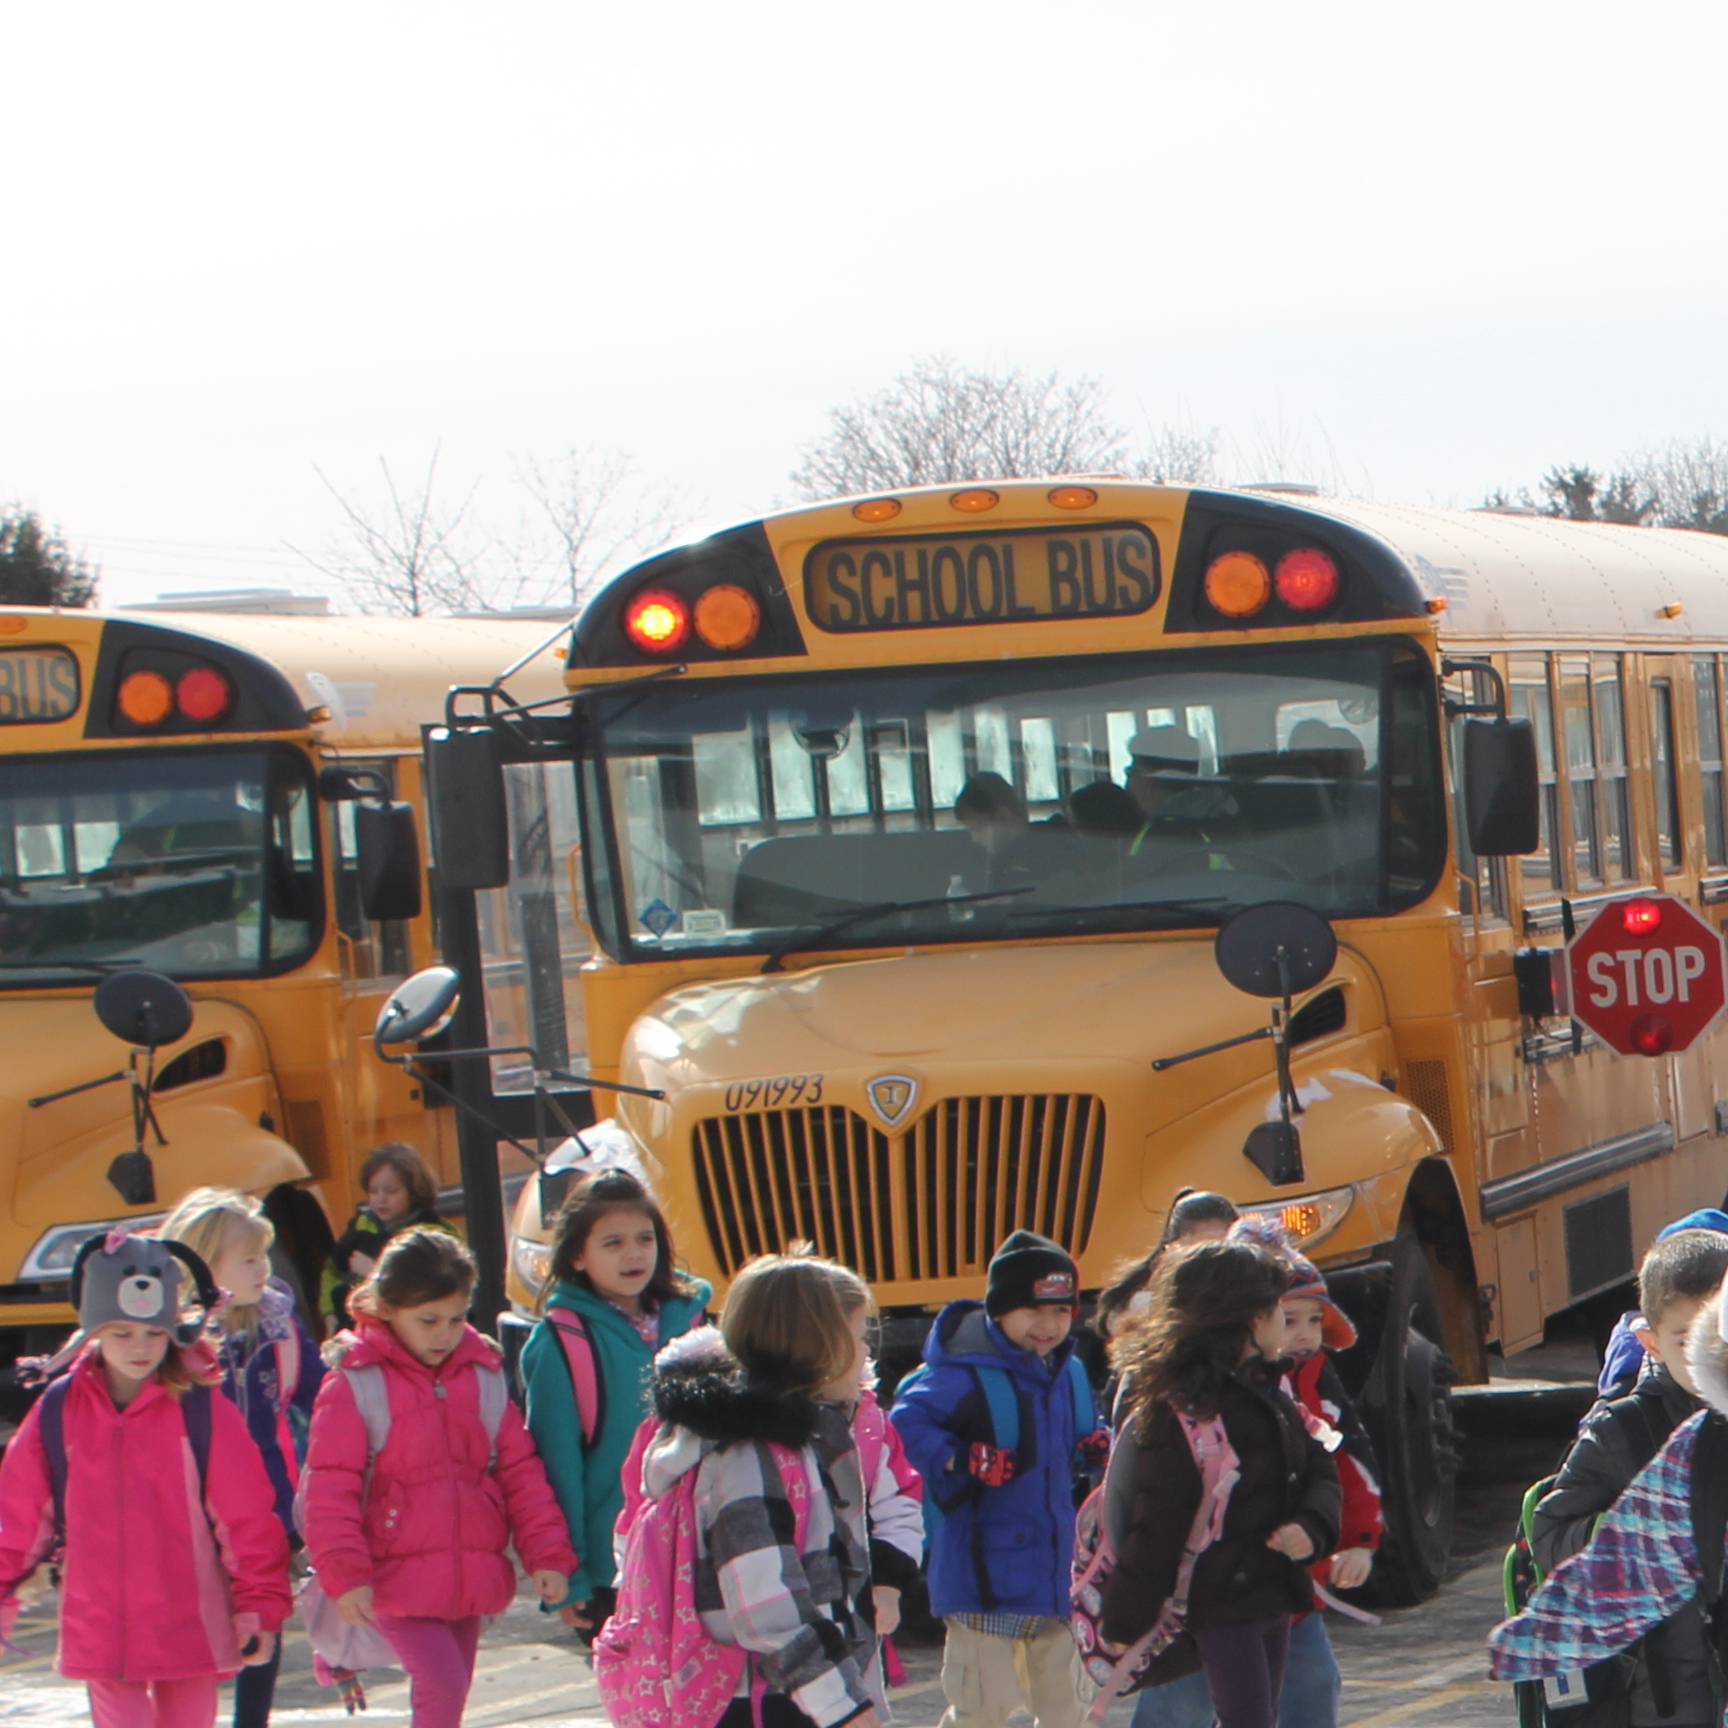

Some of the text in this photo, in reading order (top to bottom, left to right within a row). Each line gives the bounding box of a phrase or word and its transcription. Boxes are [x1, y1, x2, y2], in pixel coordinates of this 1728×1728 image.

[826, 532, 1152, 628] SCHOOL BUS
[1587, 945, 1706, 1009] STOP
[725, 1073, 825, 1112] 091993
